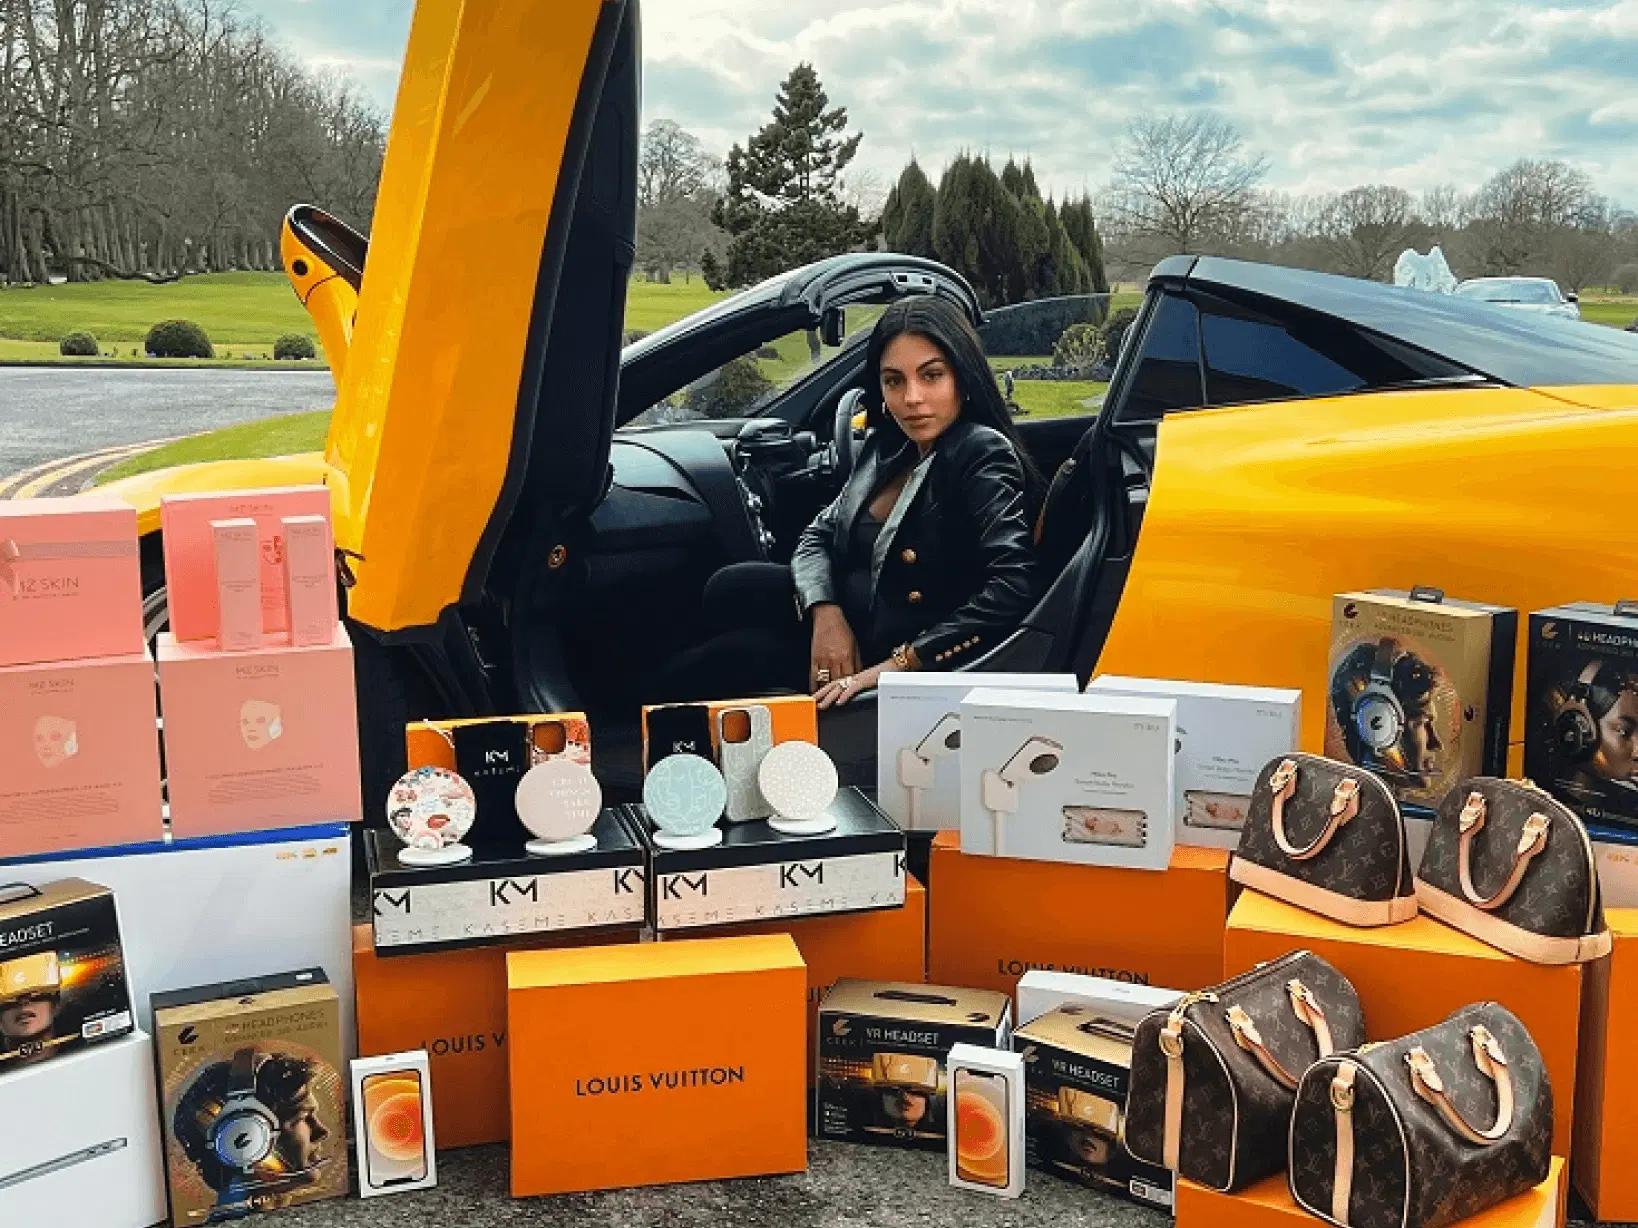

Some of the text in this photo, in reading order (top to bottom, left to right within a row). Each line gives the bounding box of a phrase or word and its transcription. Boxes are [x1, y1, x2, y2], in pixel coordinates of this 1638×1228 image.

[39, 576, 79, 591] SKIN
[485, 750, 509, 764] KM
[490, 877, 538, 907] KM
[614, 867, 645, 895] K
[663, 872, 707, 900] KM
[780, 861, 823, 889] KM
[587, 907, 645, 923] KAS
[884, 1029, 939, 1045] HEADSET
[576, 1065, 745, 1097] LOUIS VUITTON
[1069, 1063, 1120, 1088] HEADSET
